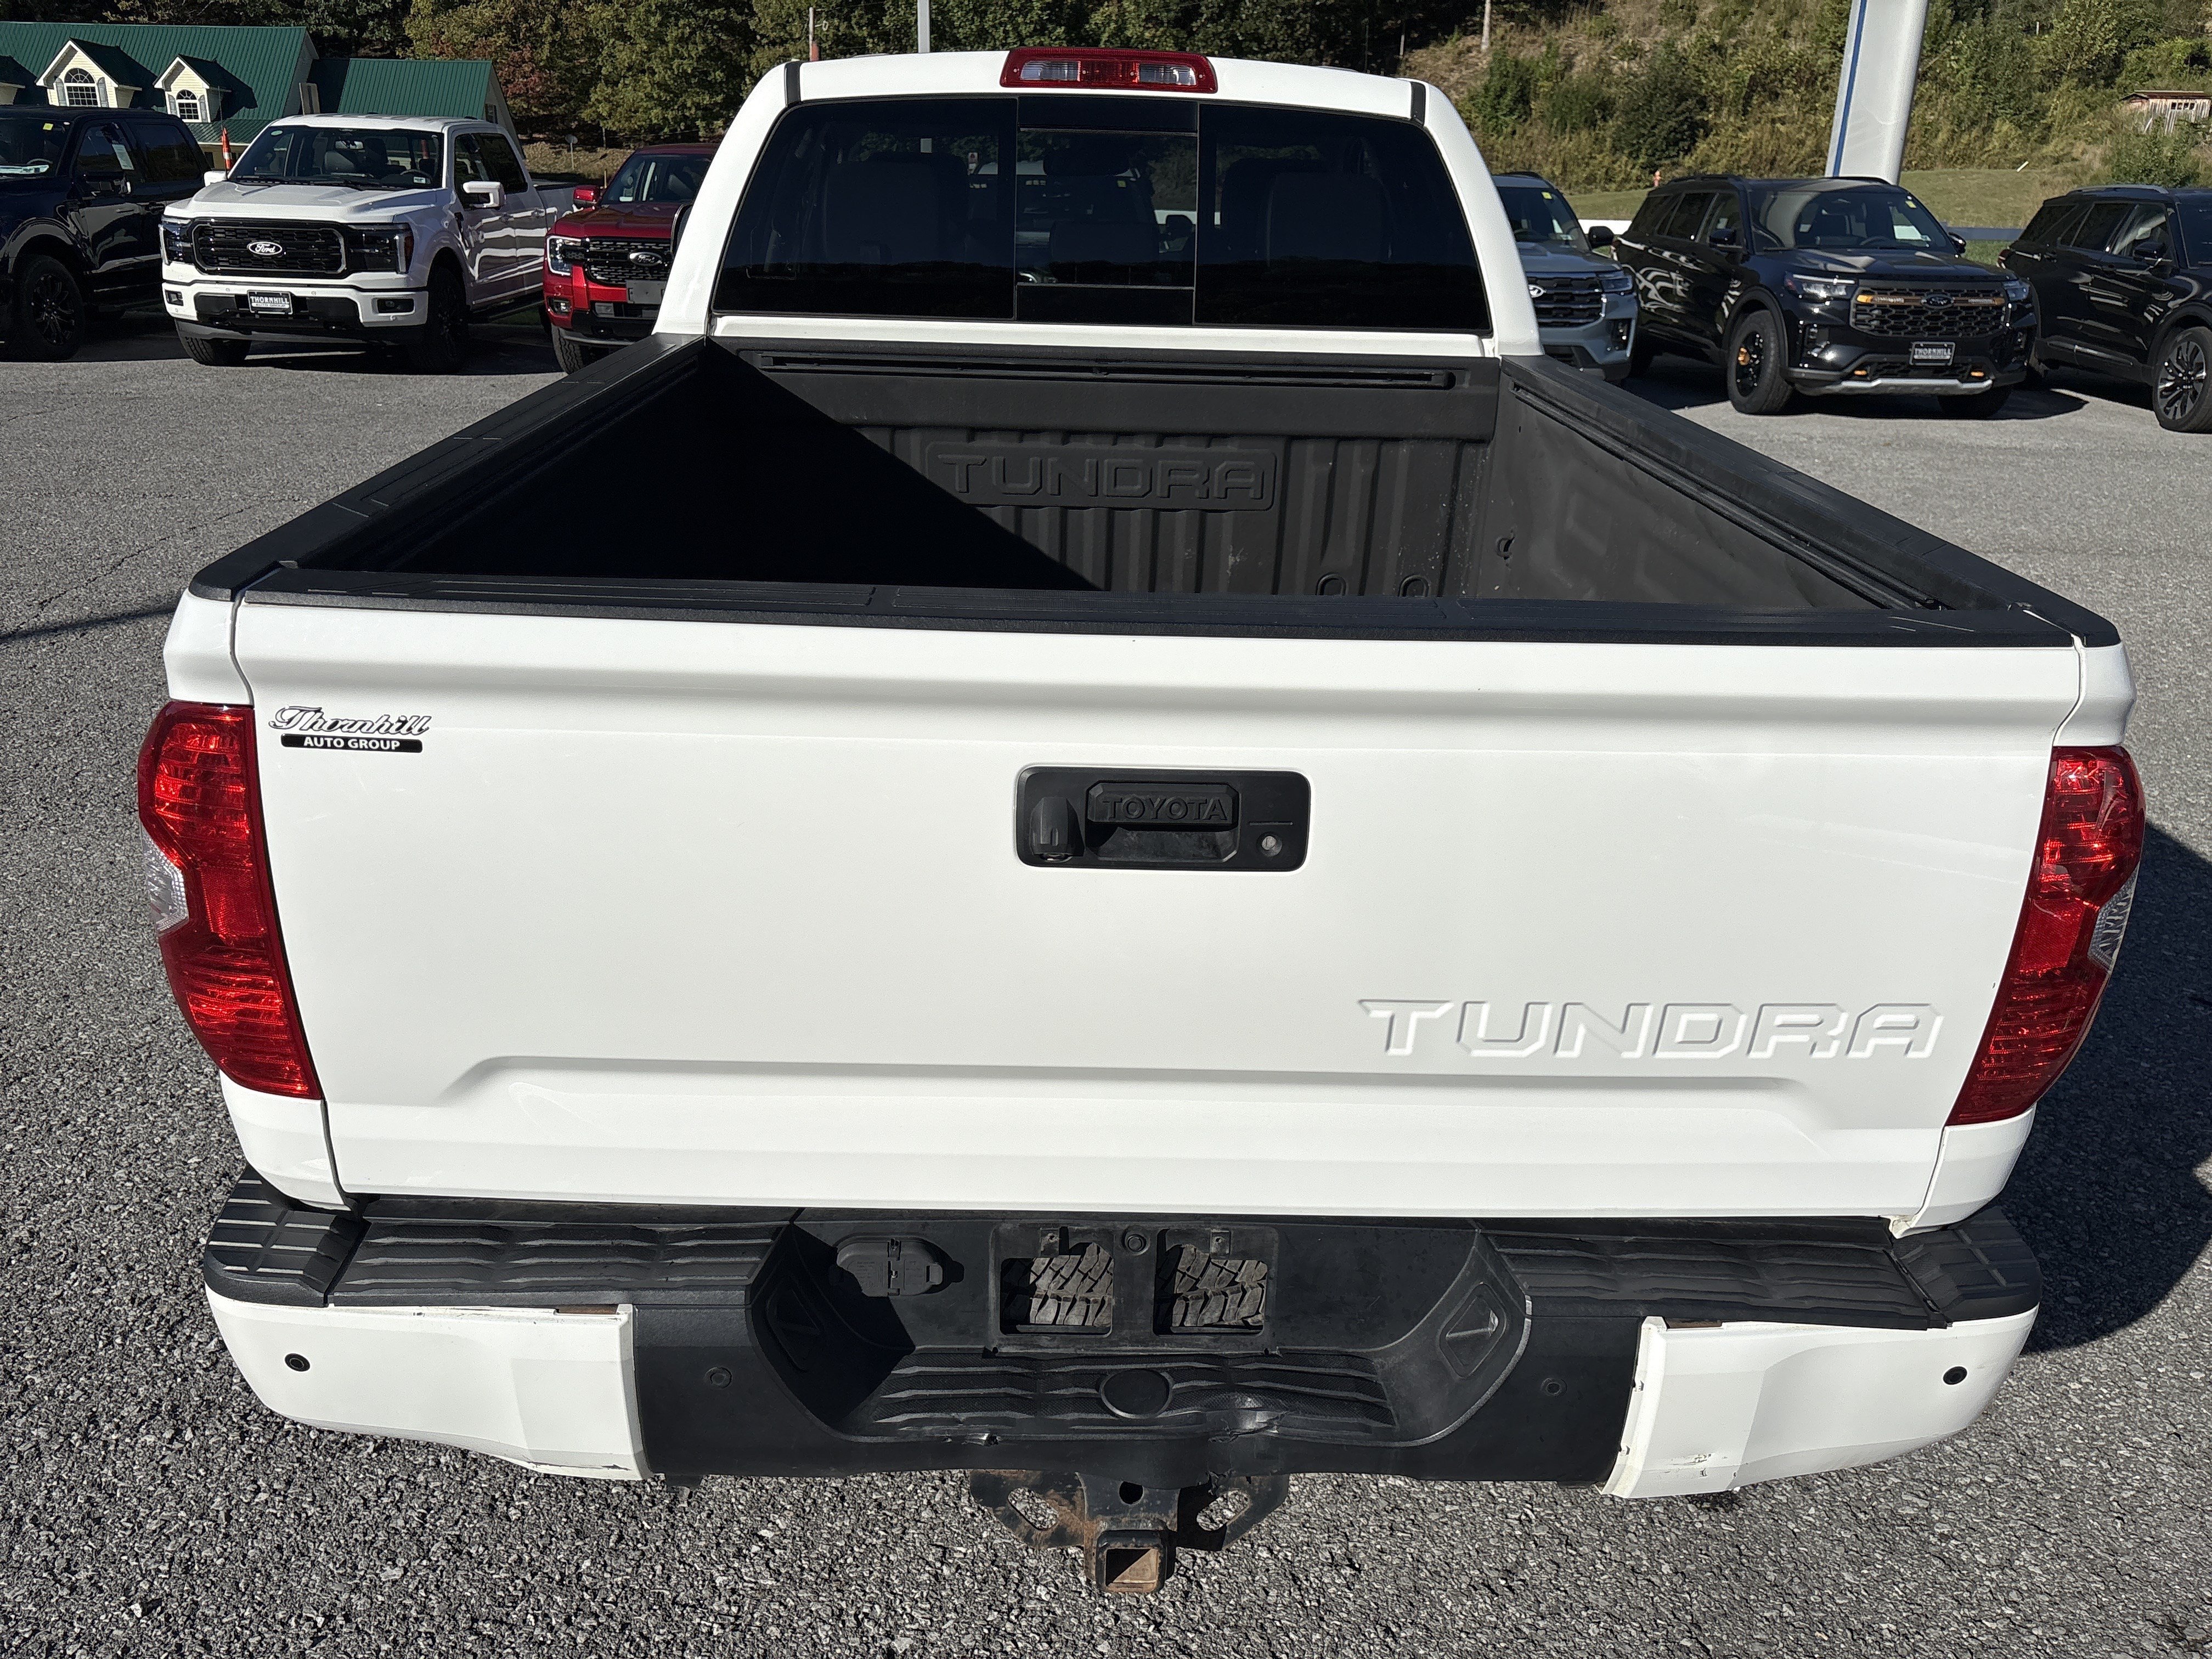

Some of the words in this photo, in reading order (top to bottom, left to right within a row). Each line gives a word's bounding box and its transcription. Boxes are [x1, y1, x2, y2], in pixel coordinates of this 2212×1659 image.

[255, 244, 275, 252] Ford
[937, 453, 1264, 500] TUNDRA
[268, 706, 432, 736] Thornhill
[303, 736, 344, 748] AUTO
[347, 738, 400, 750] GROUP
[1103, 796, 1228, 821] TOYOTA
[1358, 1000, 1943, 1059] TUNDRA
